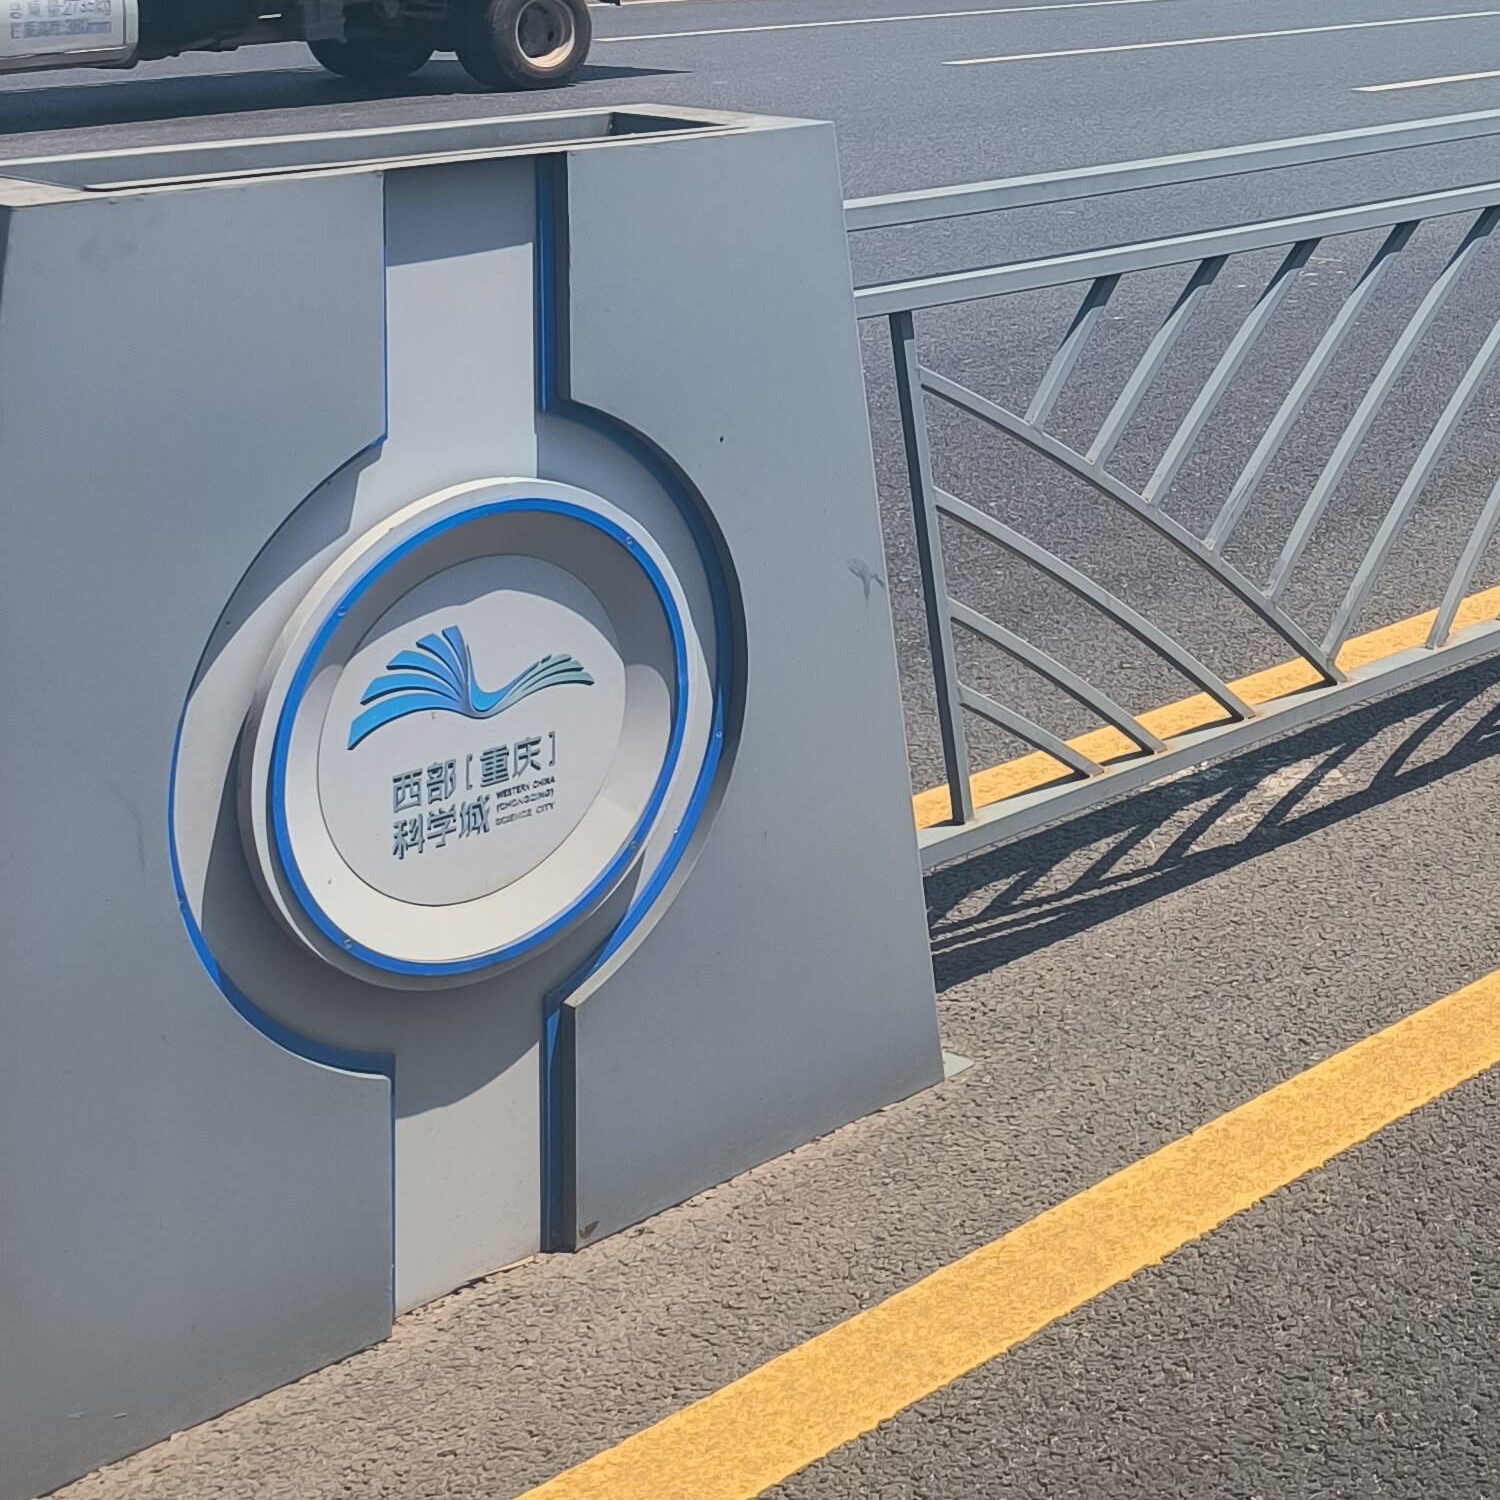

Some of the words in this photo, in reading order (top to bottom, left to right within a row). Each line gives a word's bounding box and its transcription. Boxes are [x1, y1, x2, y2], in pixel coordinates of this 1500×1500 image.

[496, 783, 530, 799] WESTERN
[532, 775, 556, 789] CHINA
[495, 808, 532, 826] SCIENCE
[535, 801, 556, 814] CITY
[392, 793, 493, 860] 科学城
